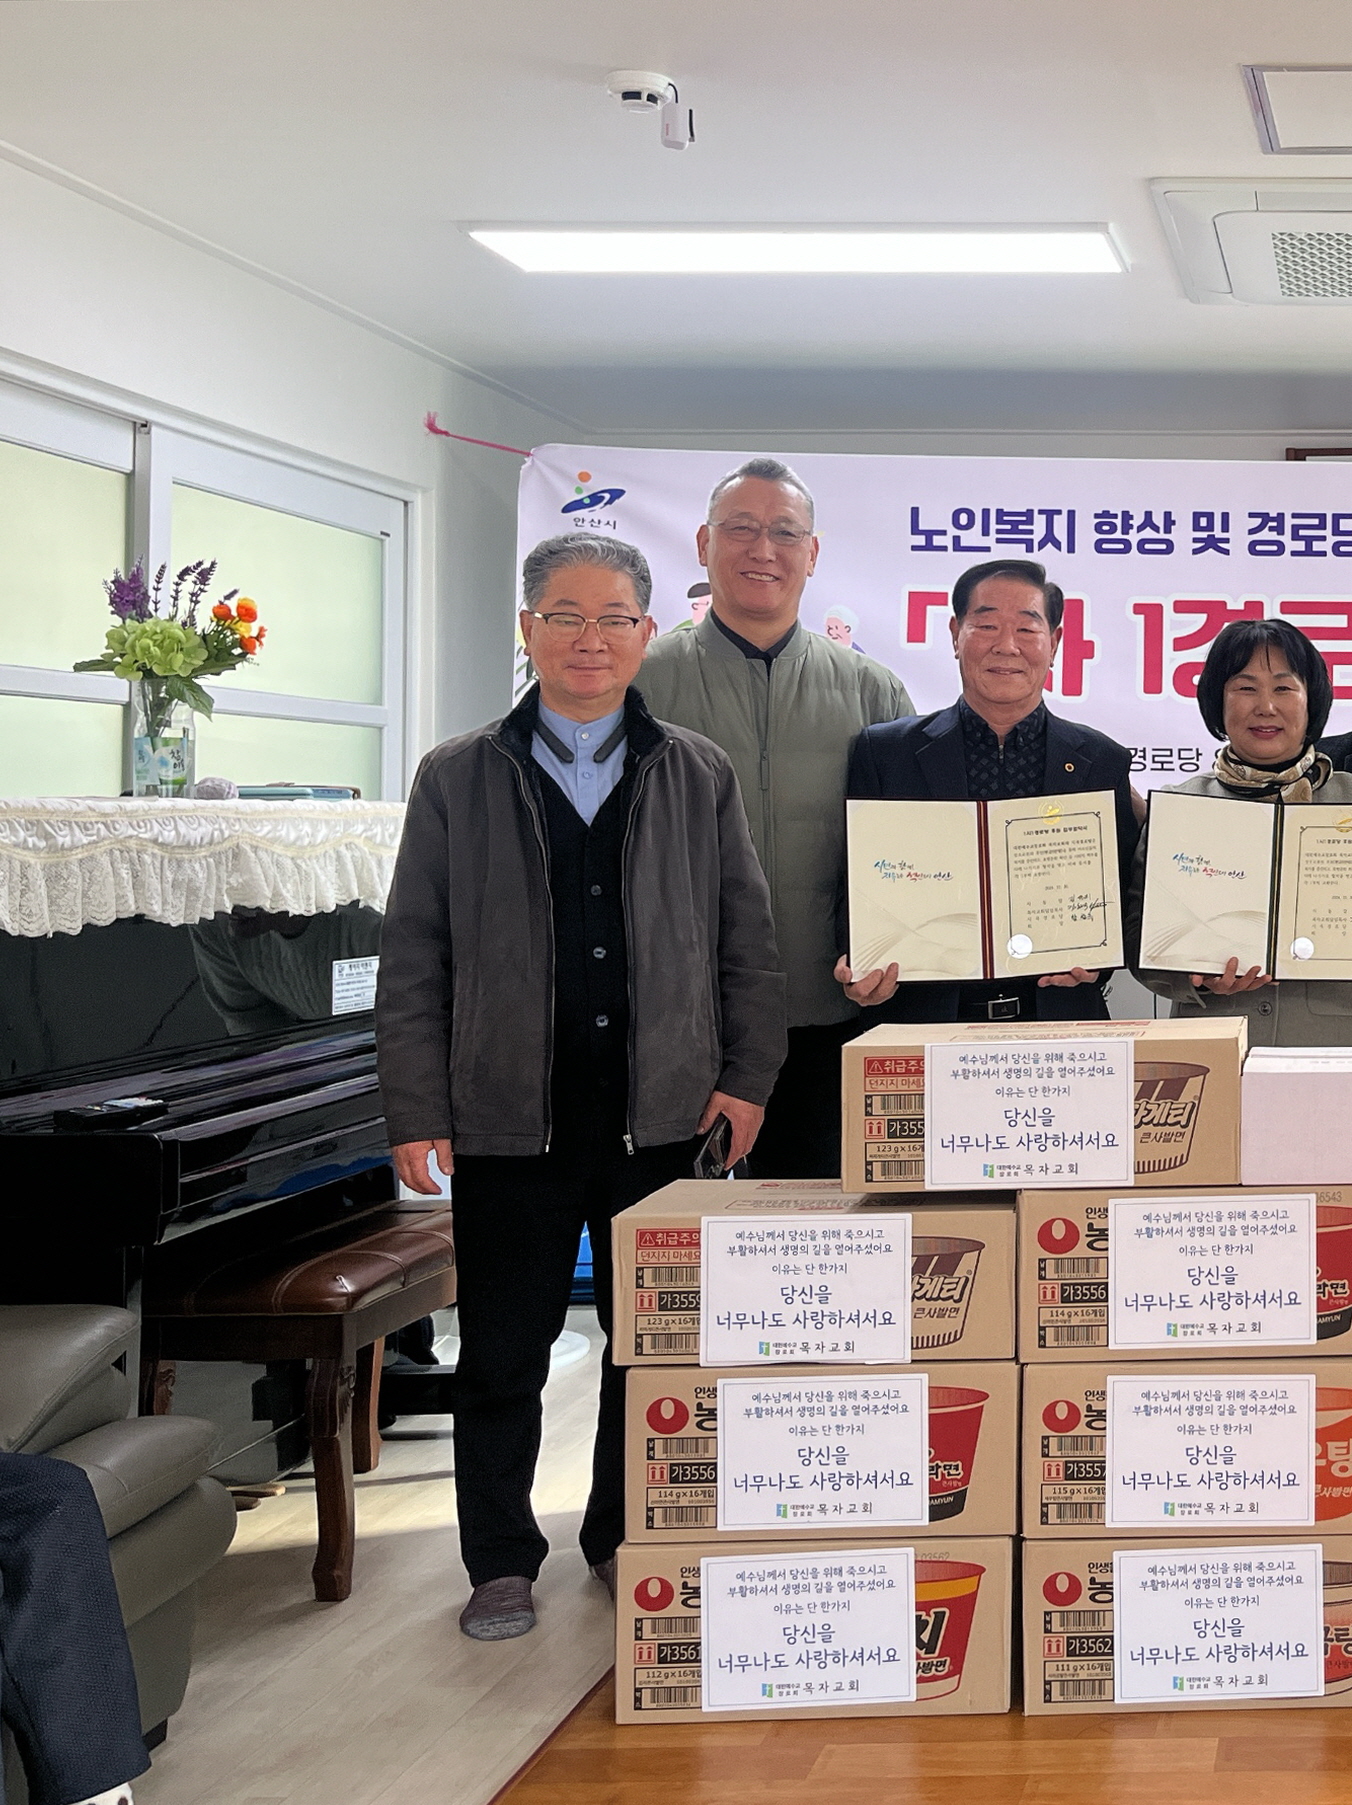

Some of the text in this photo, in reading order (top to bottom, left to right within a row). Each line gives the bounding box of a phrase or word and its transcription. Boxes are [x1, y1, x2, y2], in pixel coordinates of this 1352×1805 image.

[573, 517, 616, 530] 안산시
[910, 507, 1076, 554] 노인복지
[1093, 509, 1176, 556] 향상
[1192, 511, 1231, 556] 및
[1004, 1106, 1055, 1127] 당신을
[889, 1121, 925, 1136] 가355
[1140, 1131, 1186, 1143] 큰사발면
[940, 1130, 1119, 1153] 너무나도 사랑하셔서요
[1085, 1207, 1108, 1219] 인생
[735, 1228, 884, 1242] 예수님께서 당신을 위해 죽으시고
[779, 1243, 808, 1256] 생명의
[812, 1243, 831, 1255] 길을
[771, 1262, 847, 1275] 이유는 단 한가지
[1187, 1264, 1238, 1286] 당신을
[780, 1283, 832, 1305] 당신을
[1063, 1285, 1106, 1301] 가3556
[1124, 1288, 1301, 1313] 너무나도 사랑하셔서요
[716, 1308, 896, 1331] 너무나도 사랑하셔서요
[914, 1307, 960, 1319] 큰사발면
[694, 1387, 717, 1399] 인생
[1084, 1390, 1106, 1402] 인생
[797, 1444, 849, 1466] 당신을
[1185, 1444, 1236, 1465] 당신을
[672, 1465, 715, 1482] 가3556
[733, 1468, 913, 1493] 너무나도 사랑하셔서요
[1121, 1469, 1300, 1491] 너무나도 사랑하셔서요
[735, 1563, 887, 1583] 예수님께서 당신을 위해 죽으시고
[1147, 1559, 1295, 1576] 예수님께서 당신을 위해 죽으시고
[780, 1582, 810, 1595] 생명의
[814, 1581, 834, 1594] 길을
[1191, 1576, 1220, 1590] 생명의
[1224, 1576, 1243, 1588] 길을
[773, 1599, 850, 1615] 이유는 단 한가지
[1184, 1594, 1259, 1609] 이유는 단 한가지
[782, 1621, 835, 1645] 당신을
[1193, 1616, 1245, 1639] 당신을
[1069, 1638, 1112, 1654] 가3562
[1130, 1639, 1309, 1666] 너무나도 사랑하셔서요
[718, 1644, 900, 1674] 너무나도 사랑하셔서요
